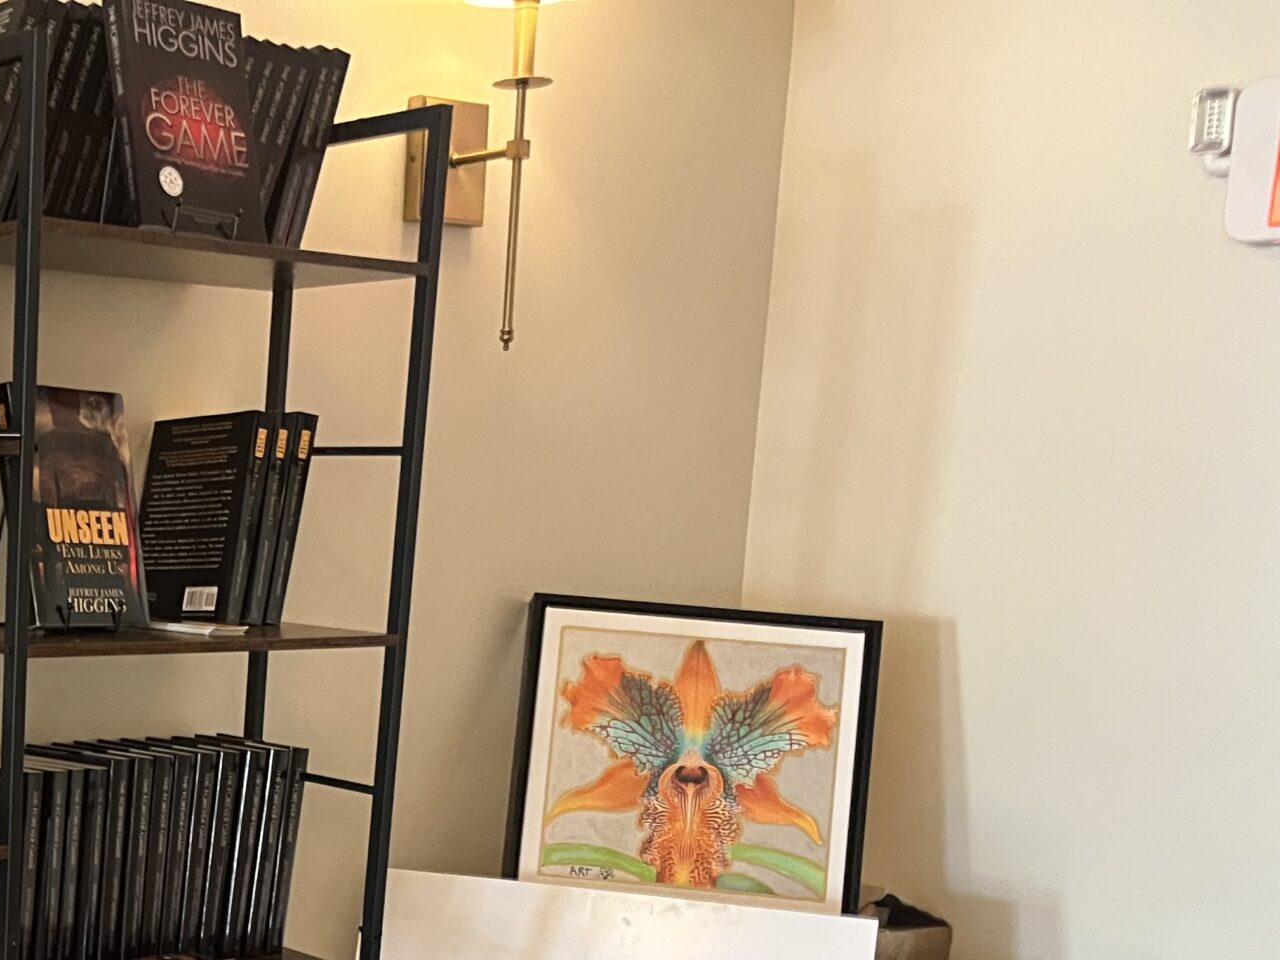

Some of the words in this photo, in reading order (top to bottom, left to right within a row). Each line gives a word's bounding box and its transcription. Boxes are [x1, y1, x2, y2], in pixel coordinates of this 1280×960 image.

[133, 14, 238, 68] HIGGINS
[189, 13, 236, 42] JAMES
[177, 75, 206, 97] THE
[151, 87, 235, 128] FOREVER
[145, 112, 249, 168] GAME
[46, 508, 129, 546] UNSEEN
